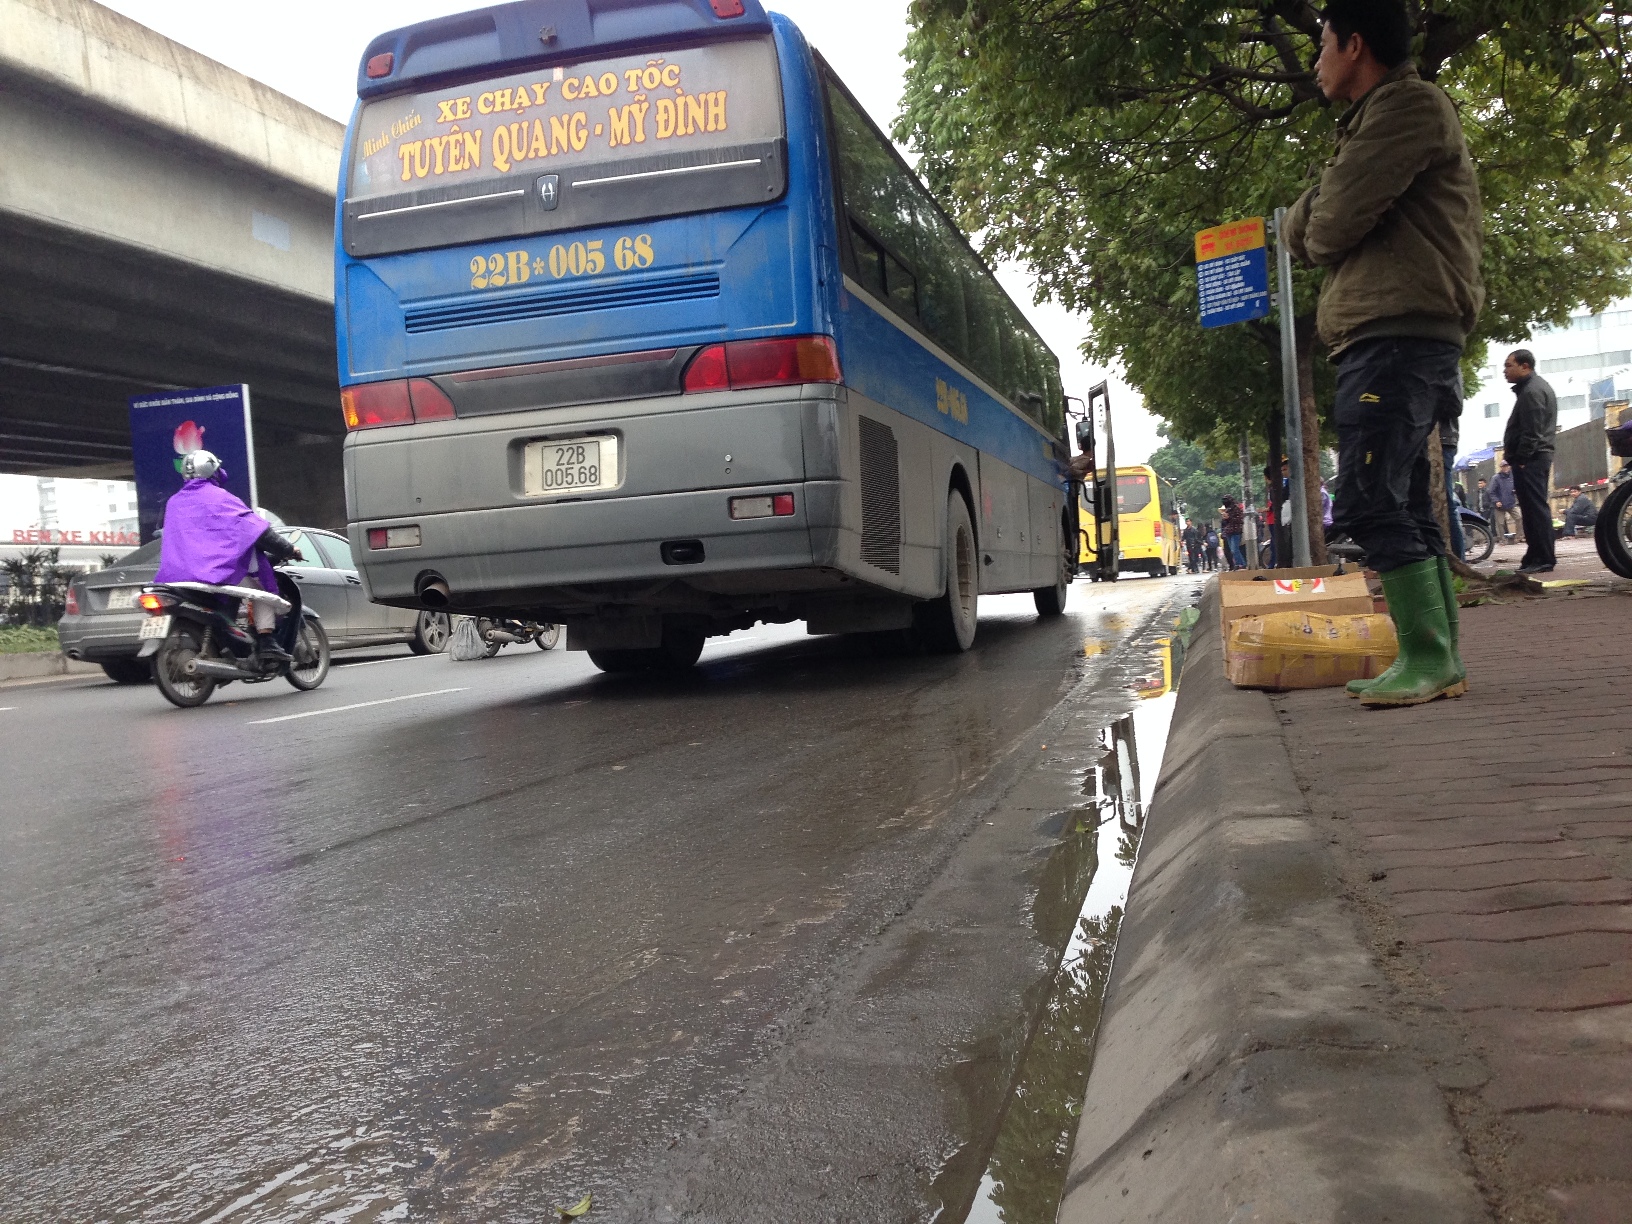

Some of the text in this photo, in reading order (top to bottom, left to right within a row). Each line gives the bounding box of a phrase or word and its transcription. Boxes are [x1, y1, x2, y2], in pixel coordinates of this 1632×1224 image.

[436, 58, 681, 124] XE CHẠY CAO TỐC
[363, 131, 390, 160] Minh
[398, 124, 483, 182] TUYÊN
[492, 110, 590, 173] QUANG
[608, 93, 650, 148] MỸ
[655, 87, 728, 140] ĐÌNH
[555, 446, 585, 466] 22B
[544, 464, 597, 487] 005.68
[58, 530, 83, 545] XE
